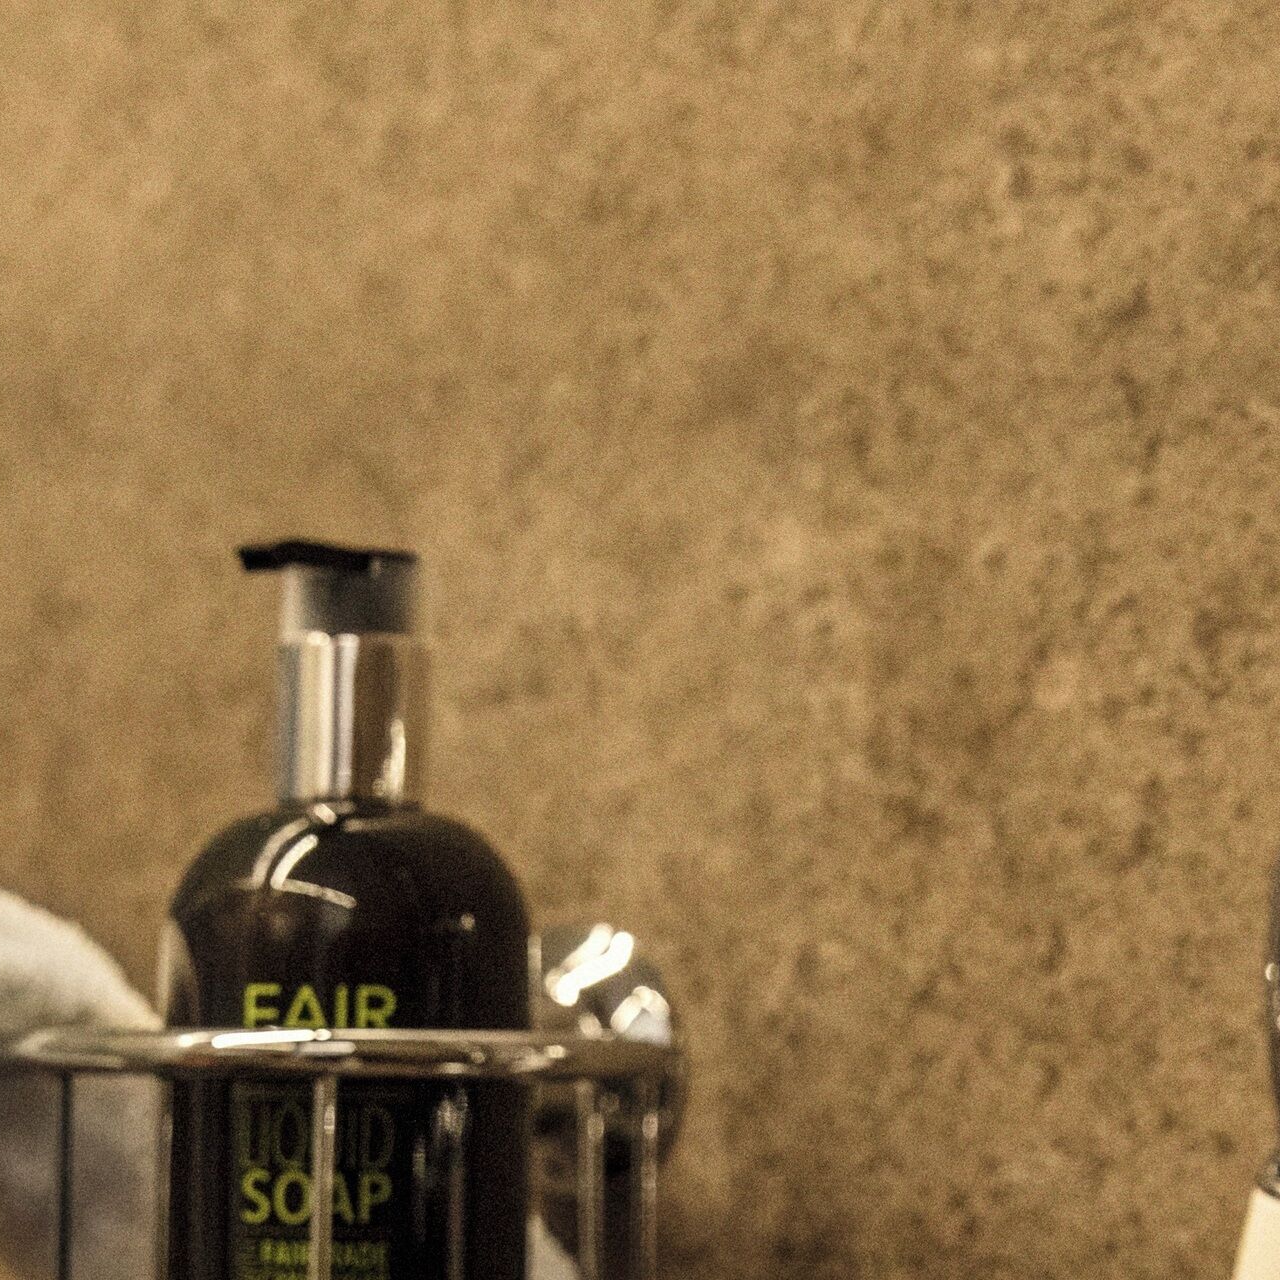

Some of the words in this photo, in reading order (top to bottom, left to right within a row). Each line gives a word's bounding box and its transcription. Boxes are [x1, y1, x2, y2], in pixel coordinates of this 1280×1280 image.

[243, 982, 398, 1029] FAIR
[238, 1104, 396, 1169] LIQID
[240, 1167, 394, 1225] SOAP
